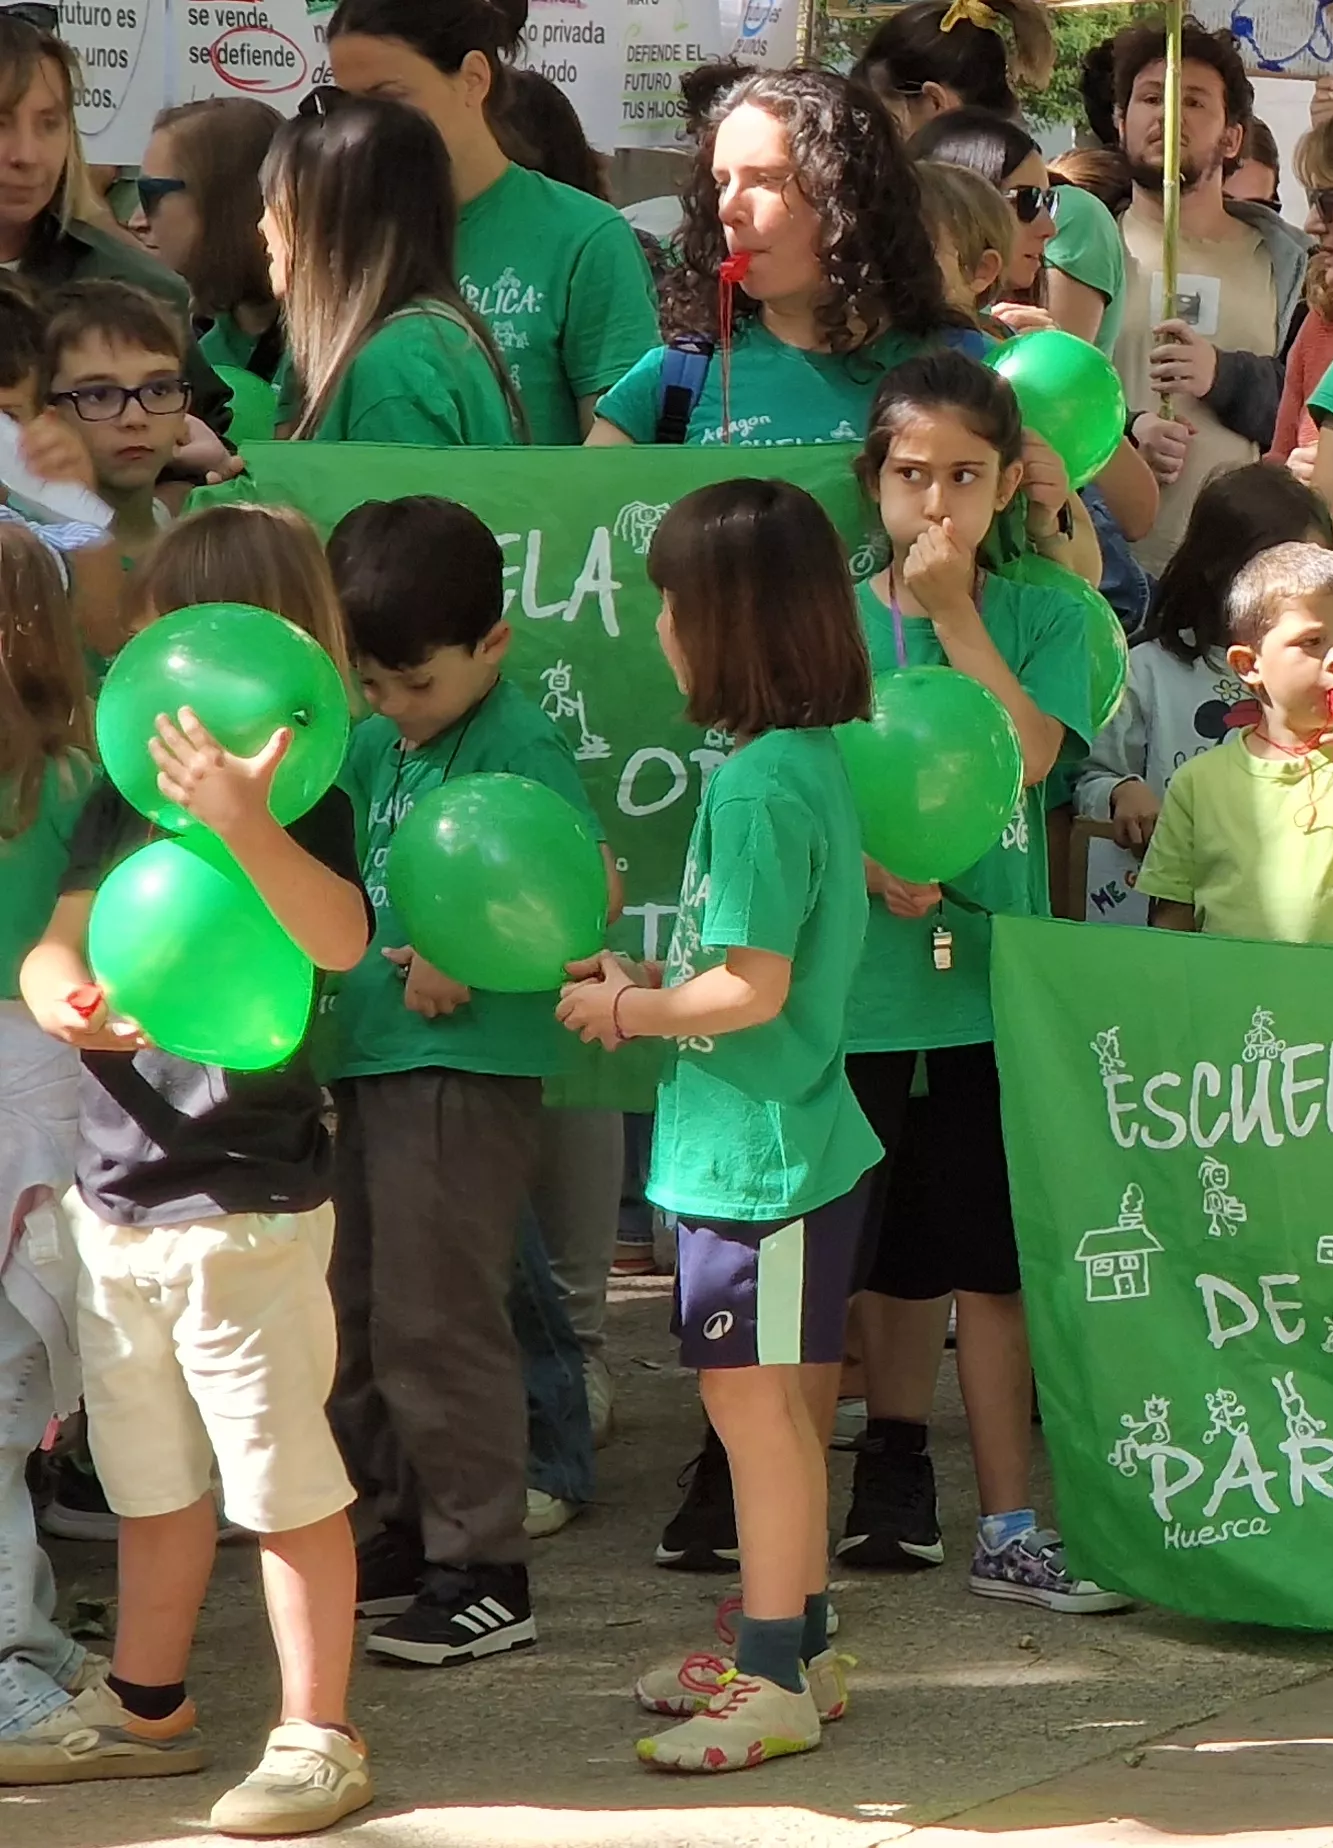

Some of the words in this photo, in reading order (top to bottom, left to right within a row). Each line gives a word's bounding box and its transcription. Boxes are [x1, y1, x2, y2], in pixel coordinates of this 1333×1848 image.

[58, 0, 112, 27] futuro
[116, 8, 137, 28] es
[188, 11, 209, 26] se
[543, 18, 605, 48] privada
[85, 47, 128, 68] unos
[189, 46, 210, 63] se
[218, 43, 295, 68] defiende
[627, 44, 680, 62] DEFIENDE
[686, 44, 706, 62] EL
[541, 59, 577, 83] todo
[624, 71, 672, 91] FUTURO
[72, 87, 117, 109] ocos.
[622, 102, 646, 119] TUS
[647, 100, 685, 119] HIJOS
[1195, 1272, 1306, 1350] DE
[1162, 1514, 1273, 1551] Huesca
